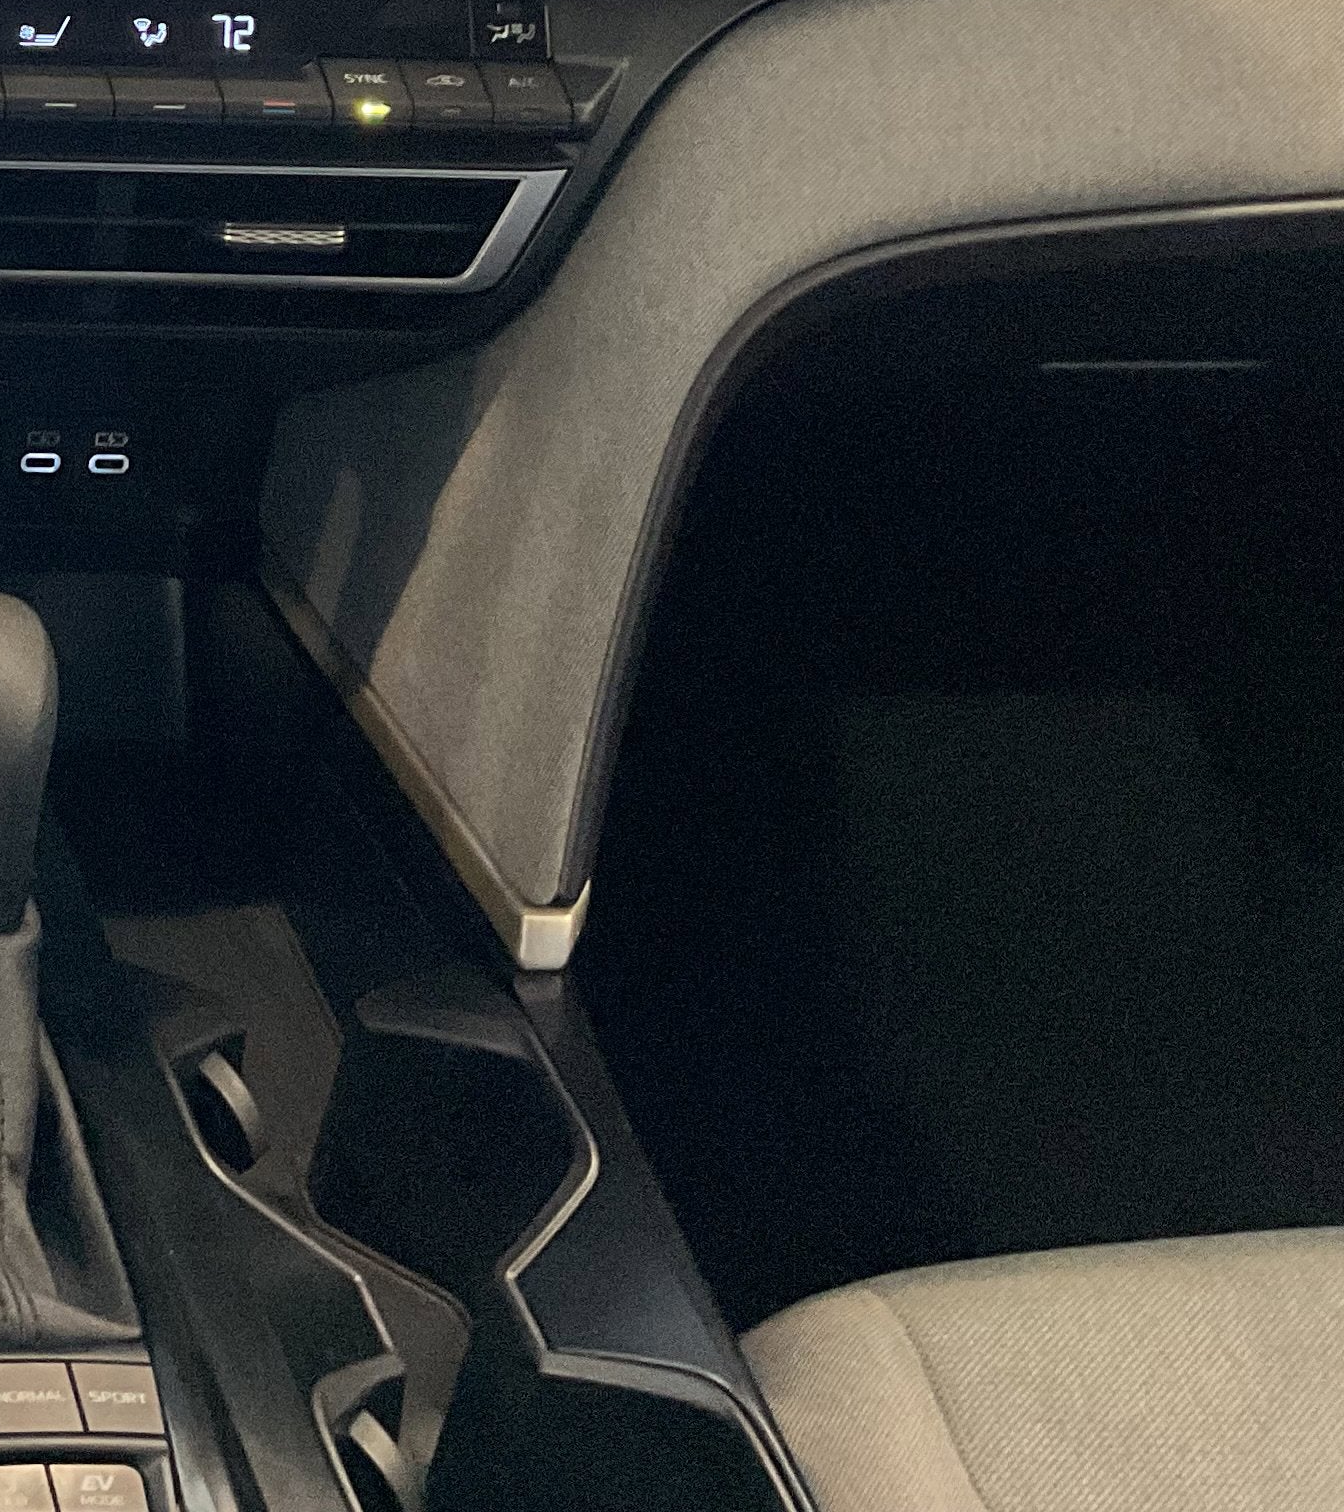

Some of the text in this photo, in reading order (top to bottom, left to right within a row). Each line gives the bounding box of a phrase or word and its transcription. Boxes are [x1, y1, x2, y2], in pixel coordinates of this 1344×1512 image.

[211, 14, 255, 51] 72
[343, 73, 389, 85] SYNC
[88, 1390, 147, 1405] SPORT
[81, 1474, 115, 1492] EV
